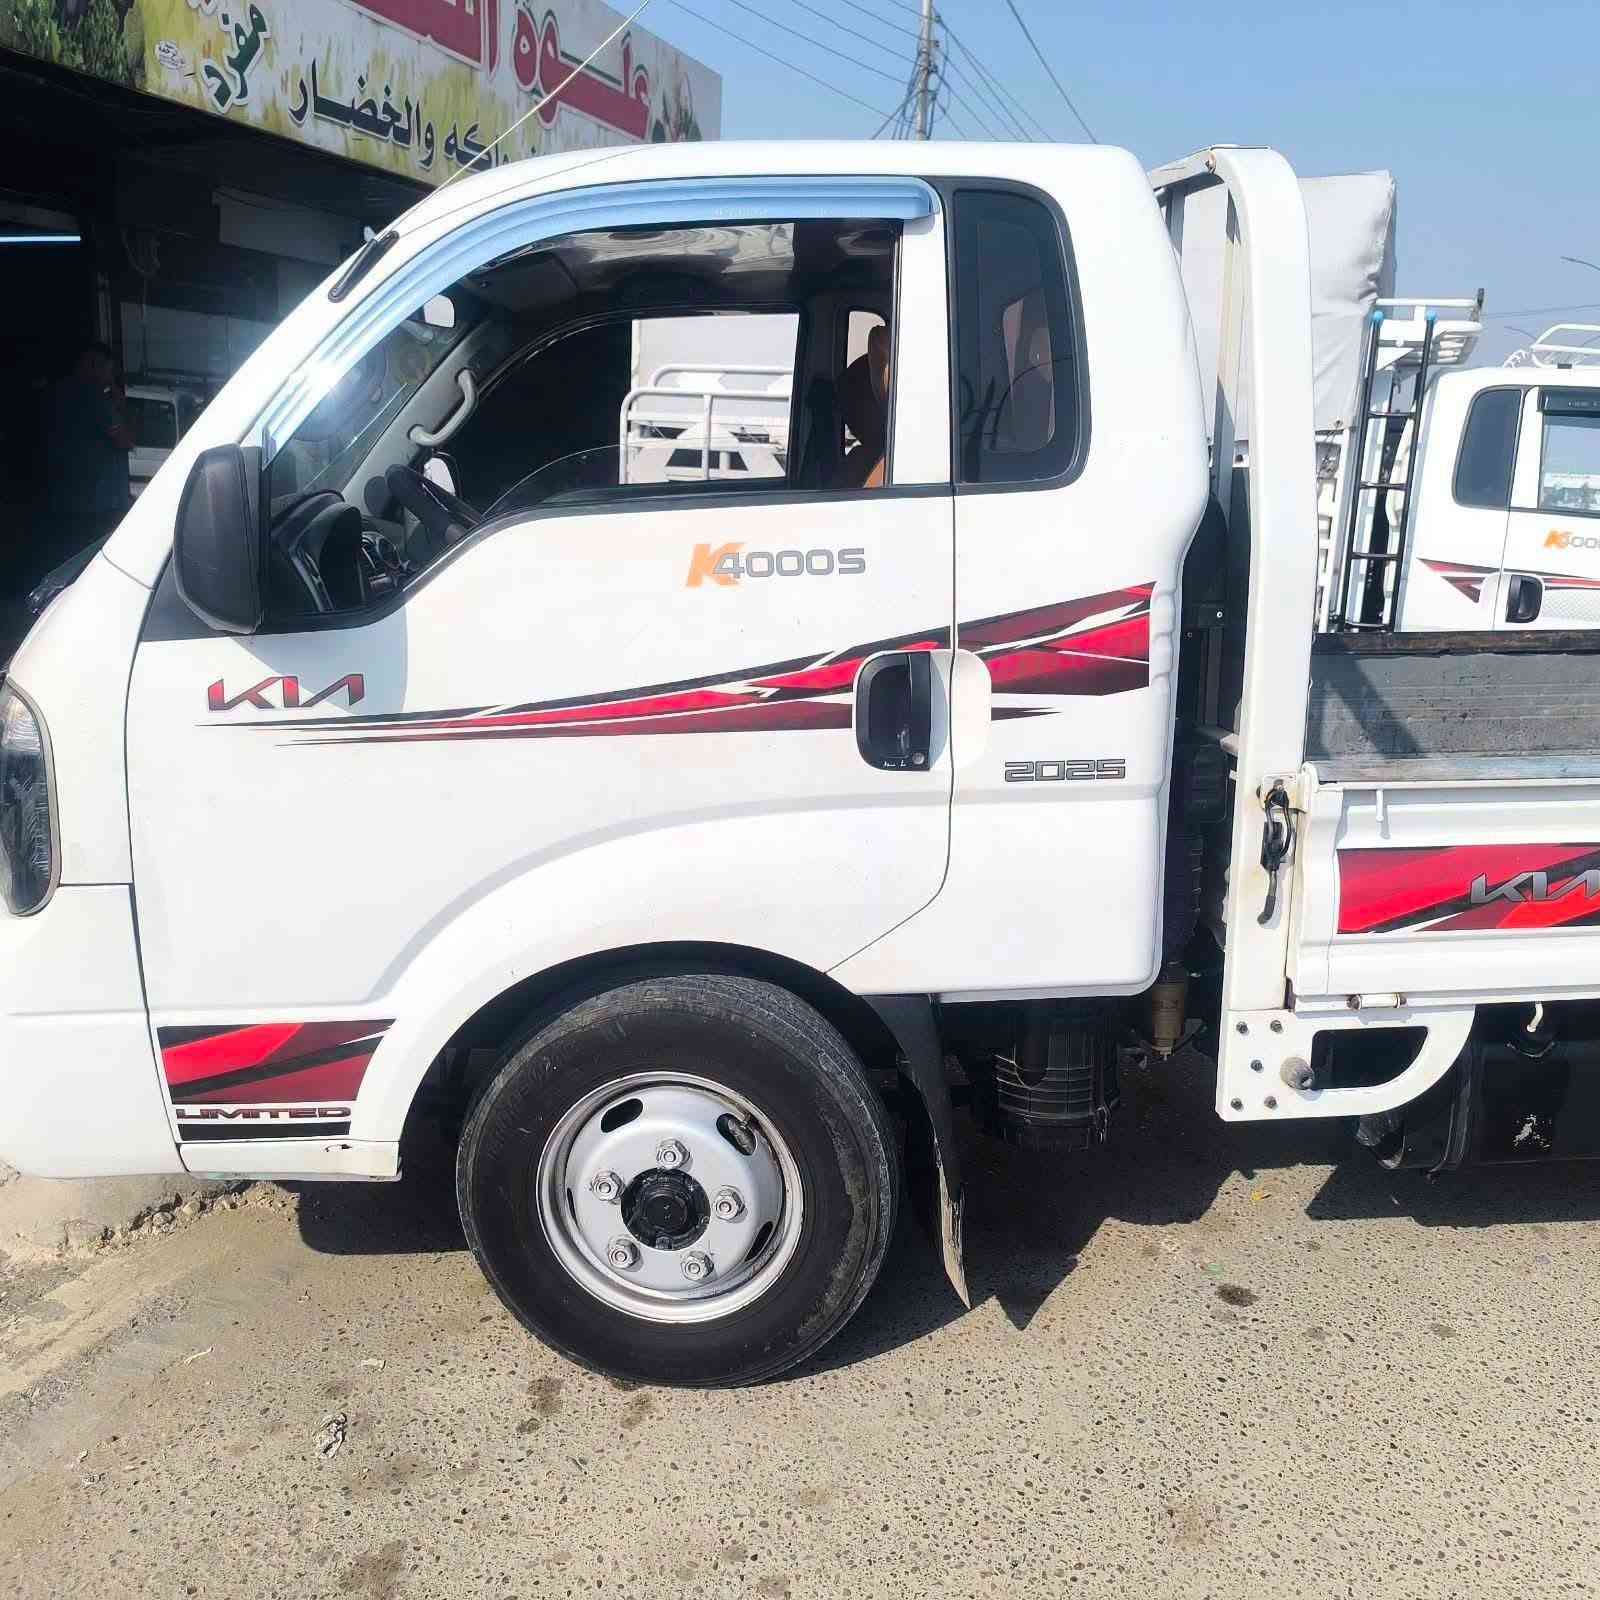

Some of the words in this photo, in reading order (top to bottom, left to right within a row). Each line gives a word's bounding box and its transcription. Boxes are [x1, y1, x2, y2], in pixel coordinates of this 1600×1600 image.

[289, 57, 435, 169] والخضار
[686, 543, 866, 588] K4000S
[207, 673, 365, 711] KIA
[1004, 758, 1126, 782] 2025
[1470, 869, 1600, 904] KIA
[175, 1106, 352, 1120] LIMITED
